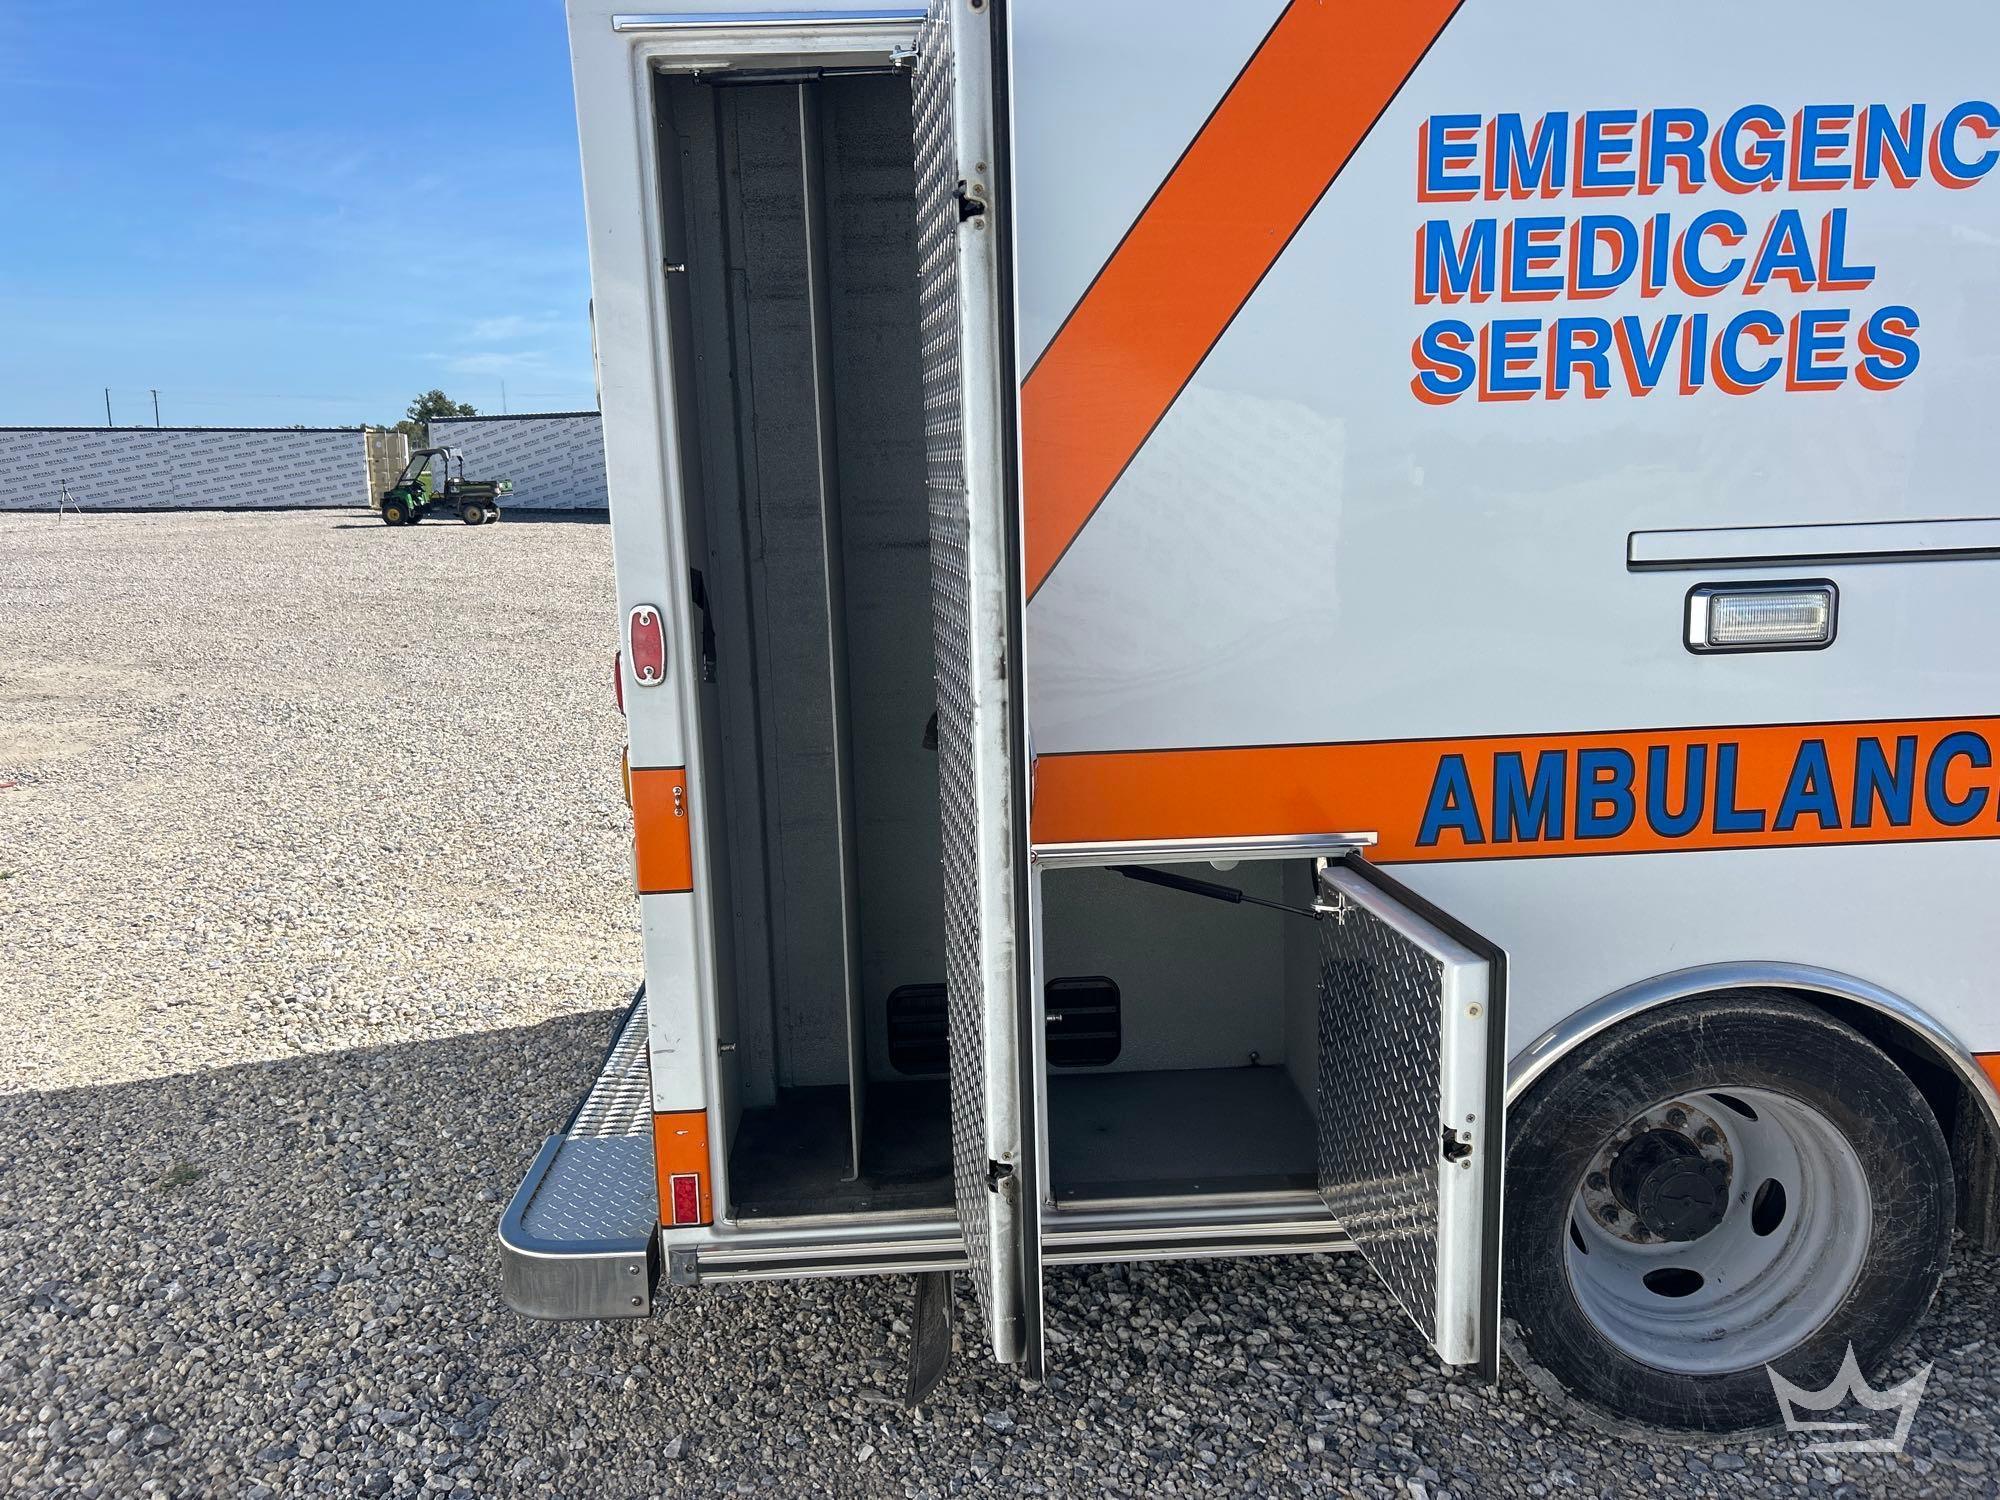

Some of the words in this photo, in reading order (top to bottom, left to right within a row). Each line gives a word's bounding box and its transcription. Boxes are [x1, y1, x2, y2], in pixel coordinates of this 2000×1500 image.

[1417, 100, 2000, 203] EMERGENC
[1414, 207, 1876, 304] MEDICAL
[1410, 305, 1920, 405] SERVICES
[1415, 730, 2000, 847] AMBULANC
